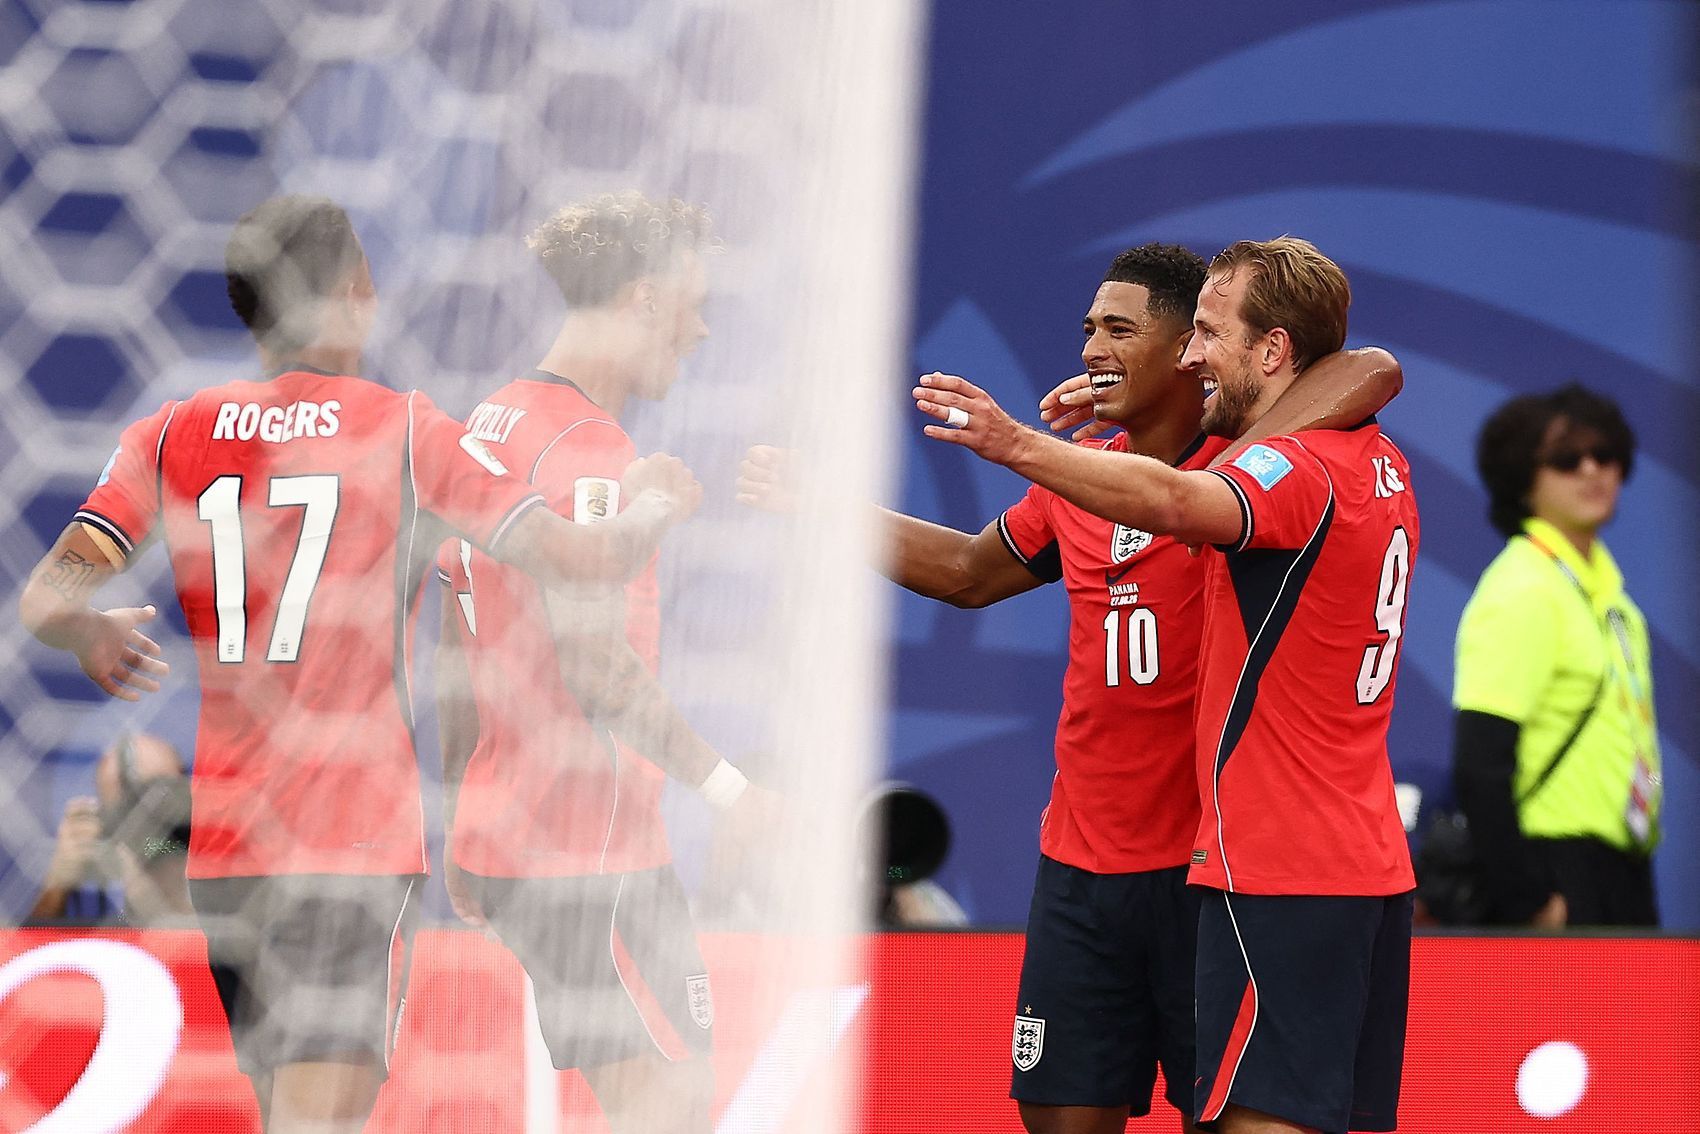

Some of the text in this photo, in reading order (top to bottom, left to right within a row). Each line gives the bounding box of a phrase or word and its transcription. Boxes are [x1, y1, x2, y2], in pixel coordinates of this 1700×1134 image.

[212, 400, 342, 443] ROGERS
[197, 475, 339, 662] 17
[1108, 582, 1139, 596] PANAMA
[1104, 607, 1160, 687] 10
[1356, 525, 1410, 705] 9
